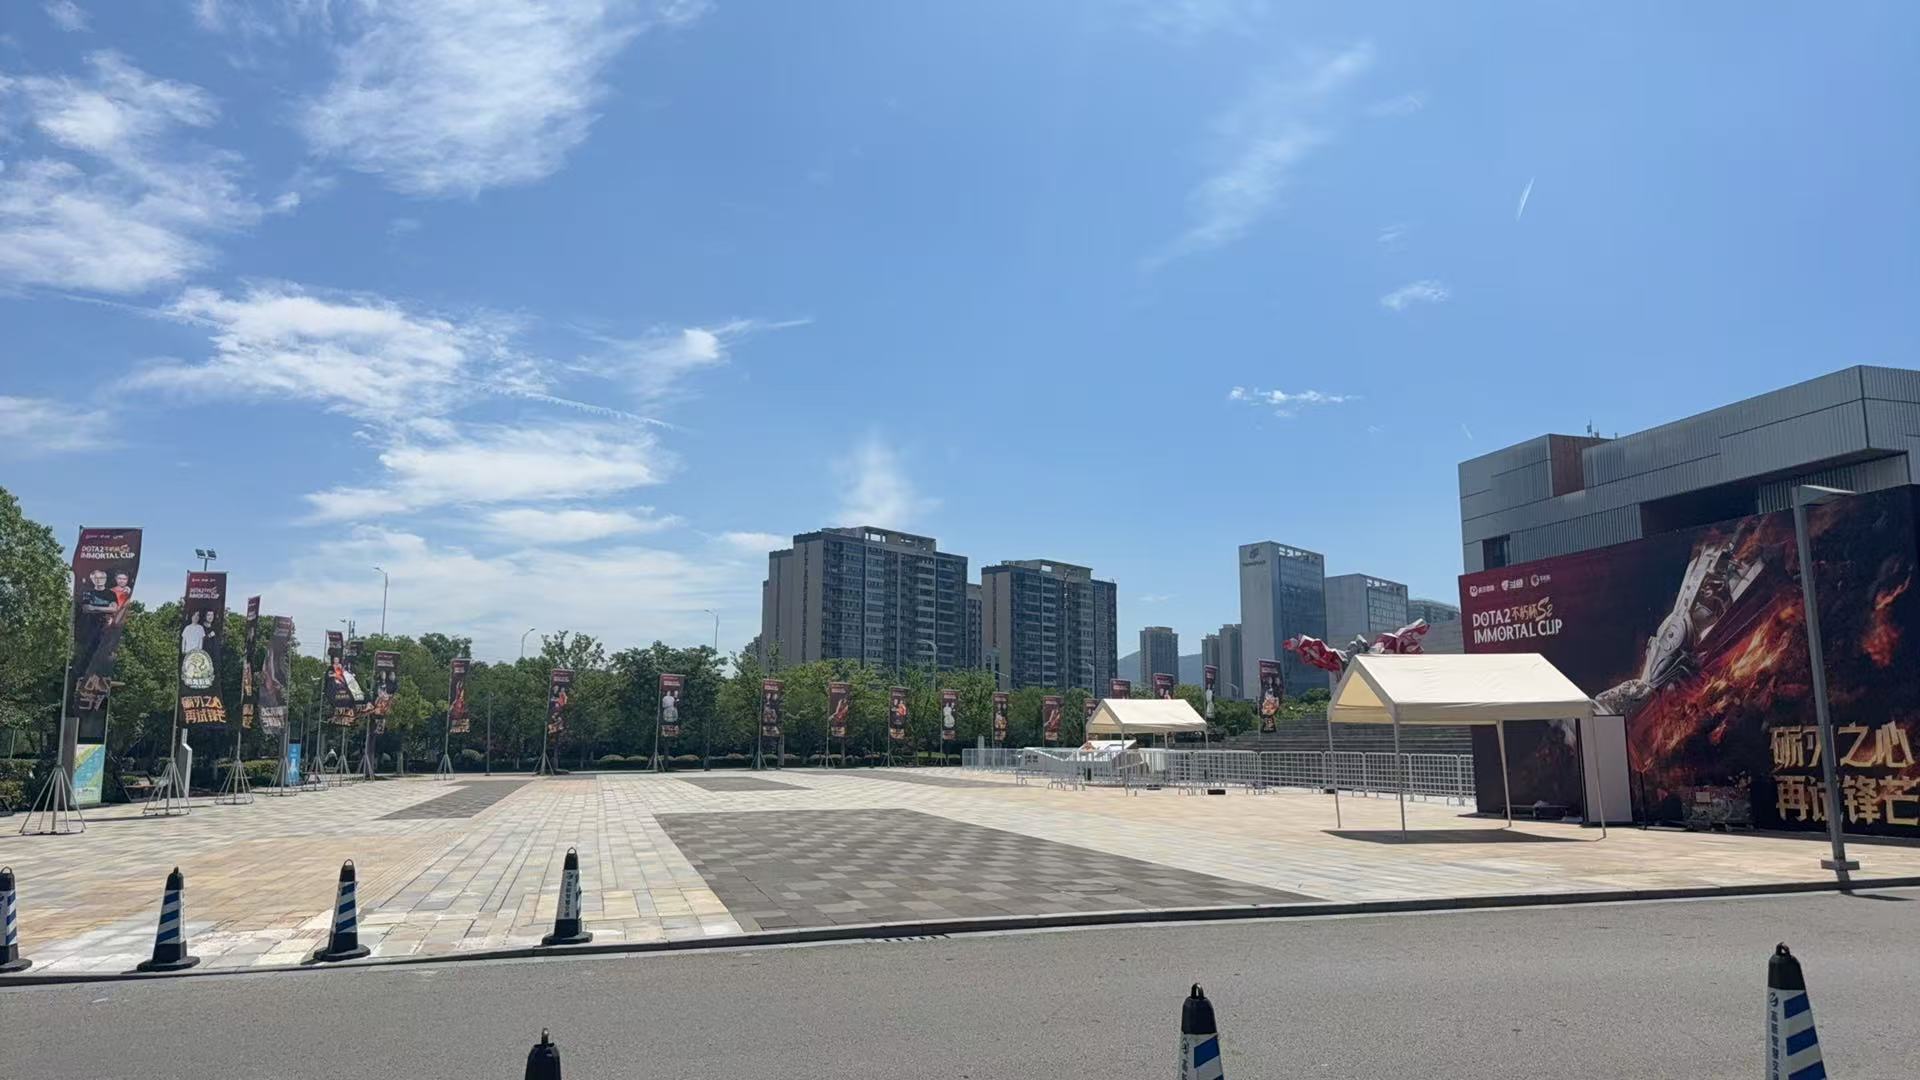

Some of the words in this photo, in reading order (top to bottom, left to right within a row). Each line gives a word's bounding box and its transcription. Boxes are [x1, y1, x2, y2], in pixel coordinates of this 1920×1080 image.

[120, 551, 136, 559] CUP
[1472, 608, 1511, 627] DOTA2
[1473, 622, 1536, 644] IMMORTAL
[1538, 618, 1563, 636] CUP
